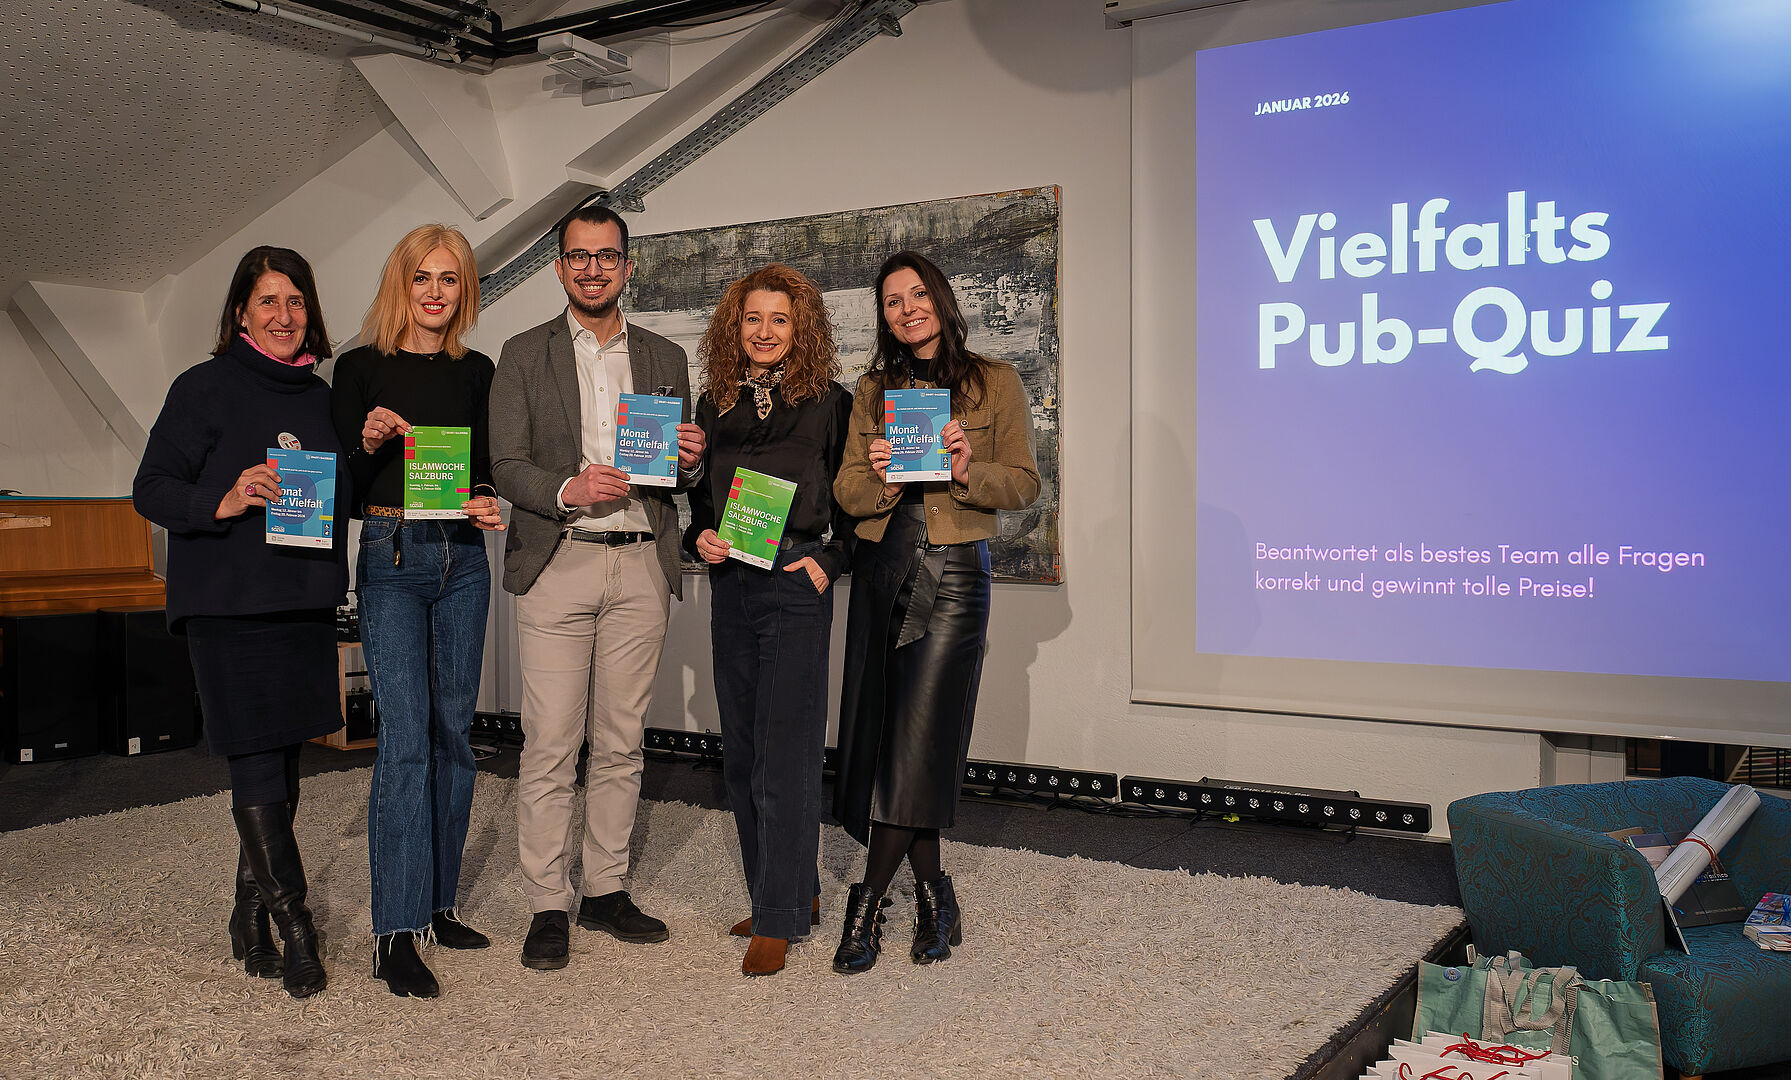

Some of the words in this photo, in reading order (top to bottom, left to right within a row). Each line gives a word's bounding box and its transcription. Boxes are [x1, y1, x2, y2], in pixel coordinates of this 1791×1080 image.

[1254, 97, 1311, 116] JANUAR
[1314, 91, 1350, 108] 2026
[1252, 190, 1610, 283] Vielfalts
[1258, 279, 1671, 375] Pub-Quiz
[620, 428, 650, 439] Monat
[889, 425, 919, 435] Monat
[619, 438, 635, 447] der
[637, 439, 669, 450] Vielfalt
[889, 435, 905, 445] der
[906, 434, 941, 444] Vielfalt
[409, 462, 466, 471] ISLAMWOCHE
[409, 472, 454, 480] SALZBURG
[280, 487, 303, 497] onat
[289, 497, 323, 509] Vielfalt
[729, 501, 782, 524] ISLAMWOCHE
[727, 510, 768, 529] SALZBURG
[1255, 542, 1378, 561] Beantwortet
[1384, 542, 1414, 562] als
[1420, 542, 1491, 564] bestes
[1497, 544, 1559, 564] Team
[1567, 543, 1610, 565] alle
[1619, 545, 1705, 572] Fragen
[1255, 570, 1321, 591] korrekt
[1327, 572, 1364, 592] und
[1371, 576, 1456, 599] gewinnt
[1462, 575, 1511, 596] tolle
[1518, 576, 1594, 598] Preise!
